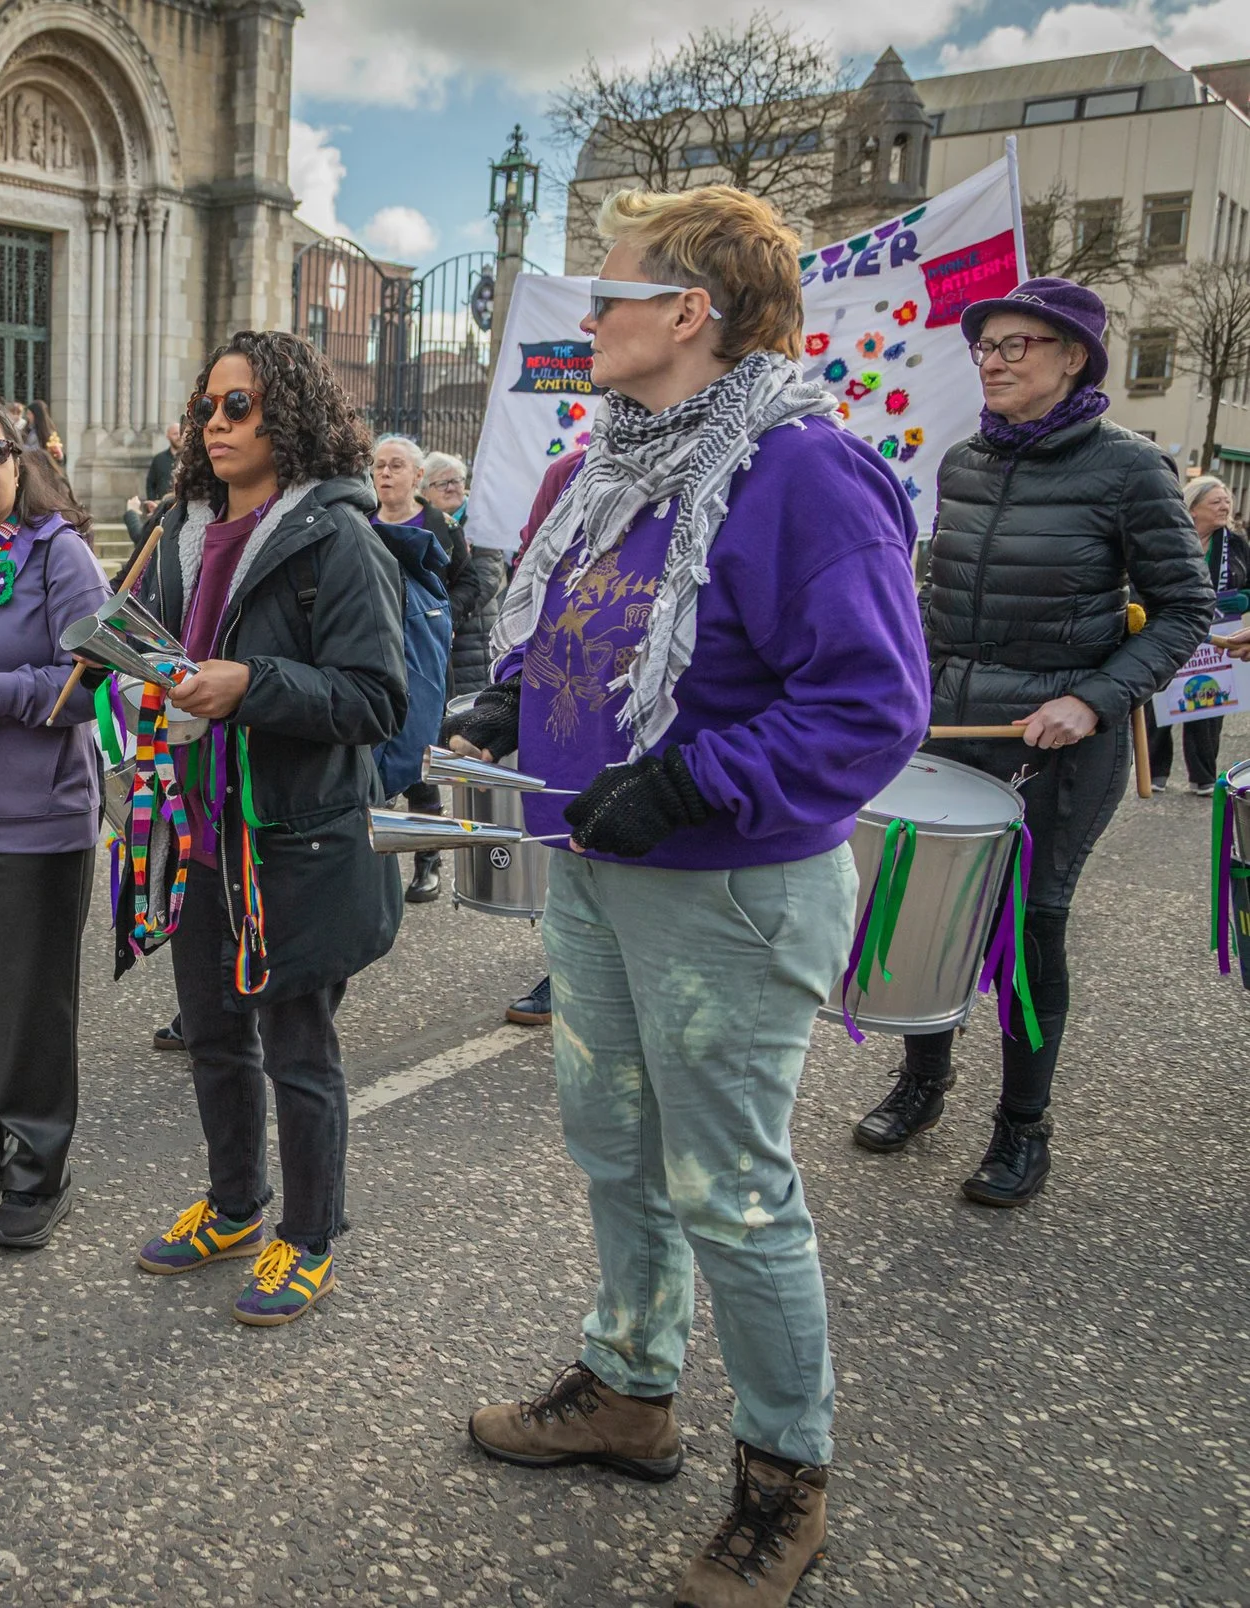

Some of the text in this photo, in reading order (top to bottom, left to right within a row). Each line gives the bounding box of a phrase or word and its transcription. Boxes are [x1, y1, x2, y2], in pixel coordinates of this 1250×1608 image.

[799, 229, 922, 287] OWER
[553, 345, 574, 358] THE
[526, 356, 593, 369] REVOLUTIO
[531, 368, 590, 380] WILL NOT
[534, 379, 593, 393] KNITTED
